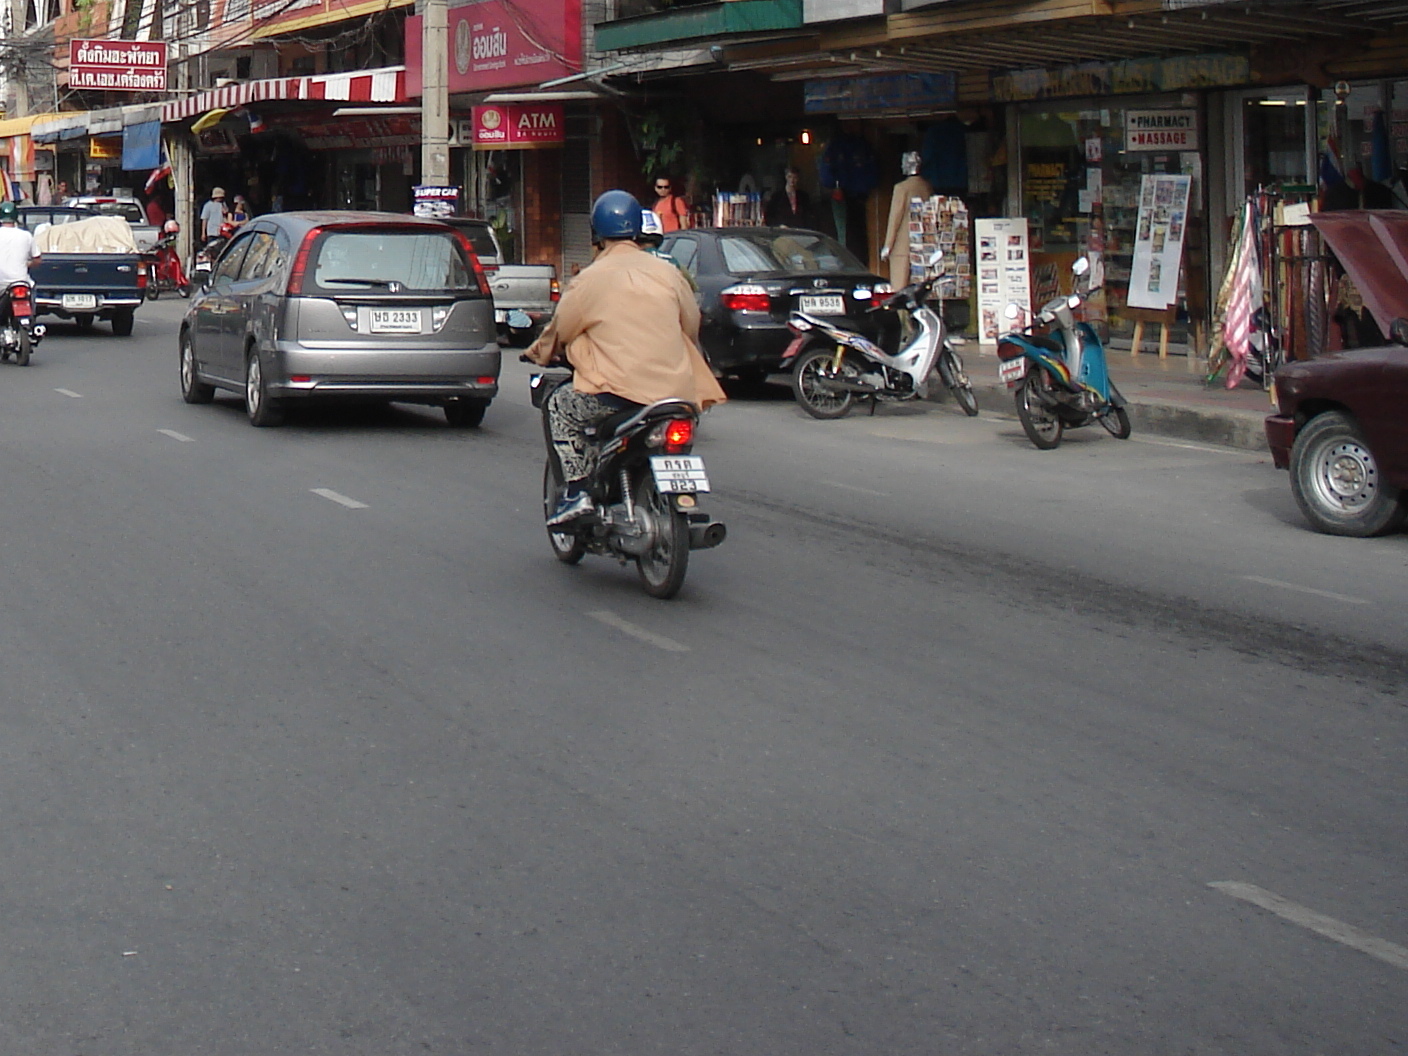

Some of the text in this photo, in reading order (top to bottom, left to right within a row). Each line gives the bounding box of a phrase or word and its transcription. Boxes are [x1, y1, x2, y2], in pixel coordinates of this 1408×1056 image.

[473, 26, 507, 60] ออมสิน
[518, 113, 556, 129] ATM
[1137, 115, 1191, 128] PHARMACY
[1138, 132, 1187, 145] MASSAGE
[415, 188, 459, 197] SUPER CAR
[392, 312, 418, 323] 2333
[670, 479, 697, 491] 823
